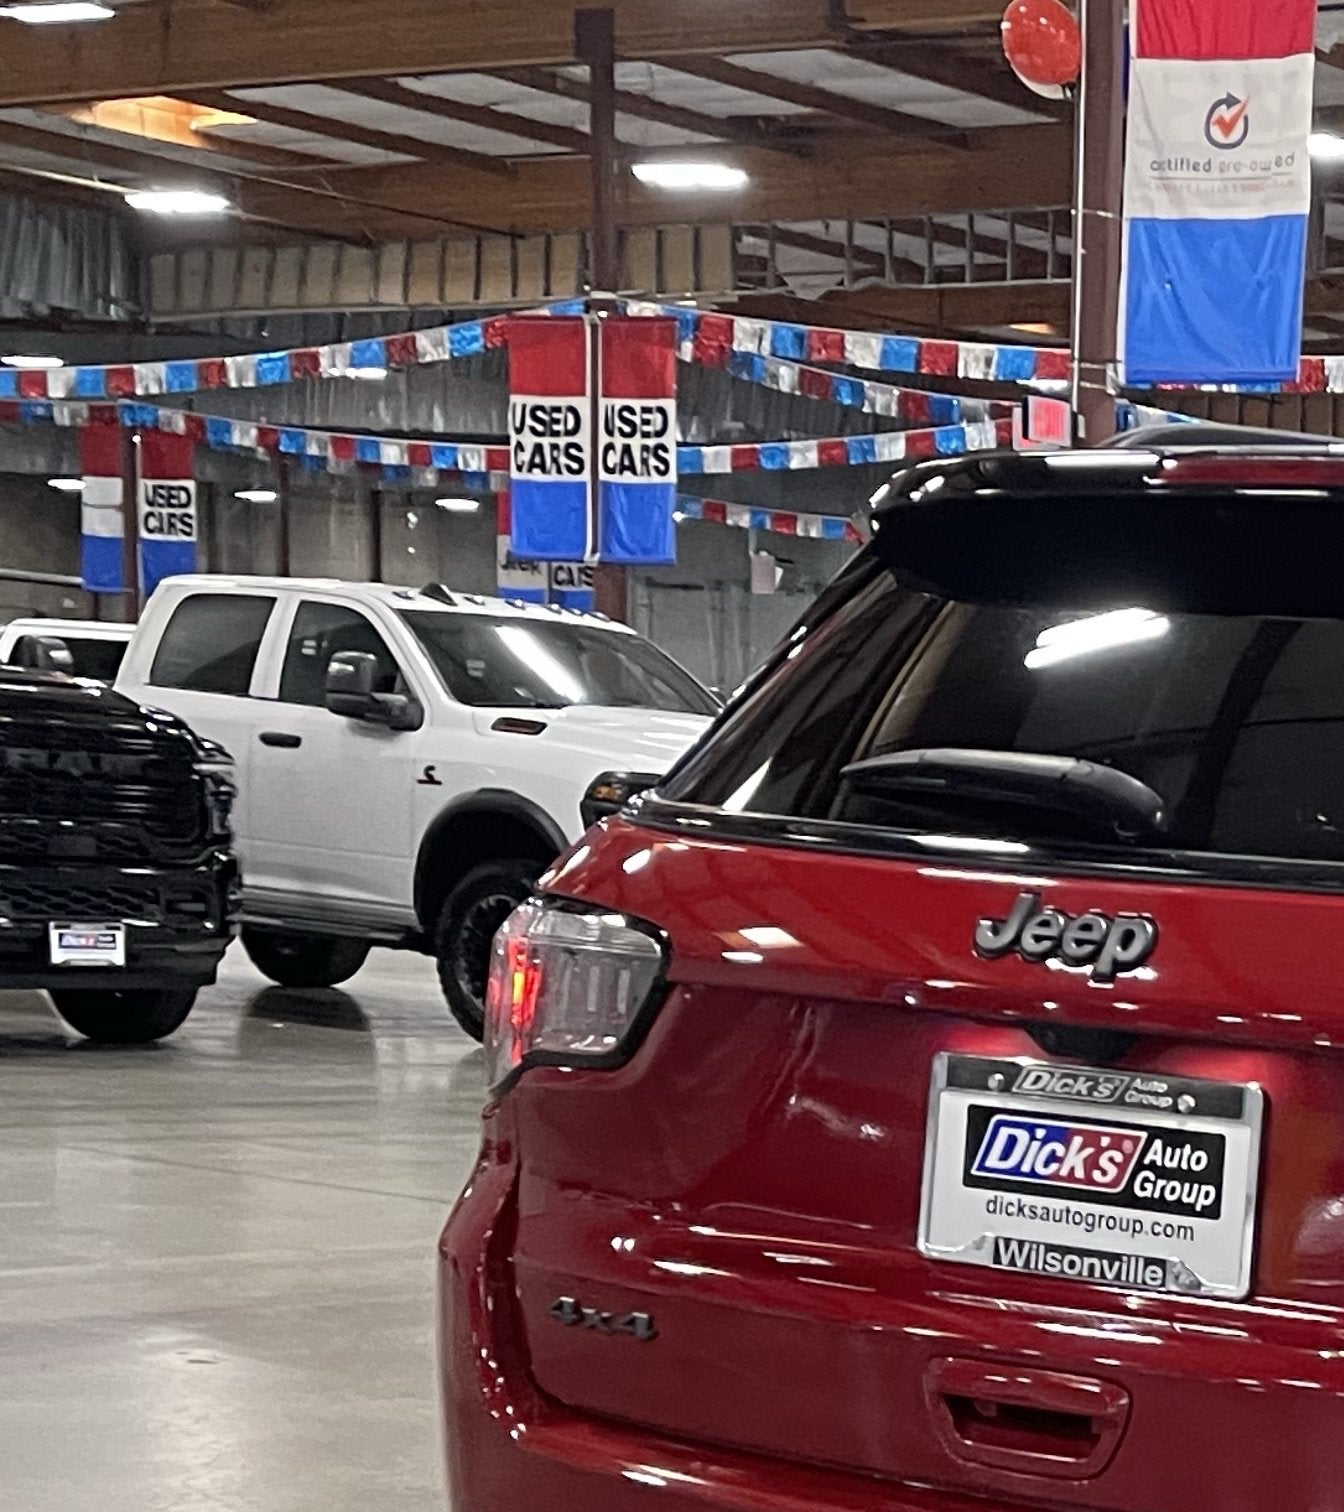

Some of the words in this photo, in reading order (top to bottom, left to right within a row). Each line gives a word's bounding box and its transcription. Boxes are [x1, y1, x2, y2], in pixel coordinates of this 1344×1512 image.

[512, 403, 582, 437] USED
[604, 404, 669, 438] USED
[513, 440, 585, 475] CARS
[602, 442, 670, 477] CARS
[144, 482, 192, 508] USED
[144, 511, 193, 537] CARS
[974, 892, 1159, 984] Jeep
[1125, 1090, 1174, 1108] Group
[1131, 1077, 1168, 1093] Auto
[984, 1126, 1124, 1184] Dick's
[1143, 1138, 1208, 1172] Auto
[1133, 1170, 1216, 1212] Group
[985, 1195, 1196, 1242] dicksautogroup.com
[998, 1238, 1164, 1287] Wilsonville
[549, 1296, 658, 1341] 4x4
